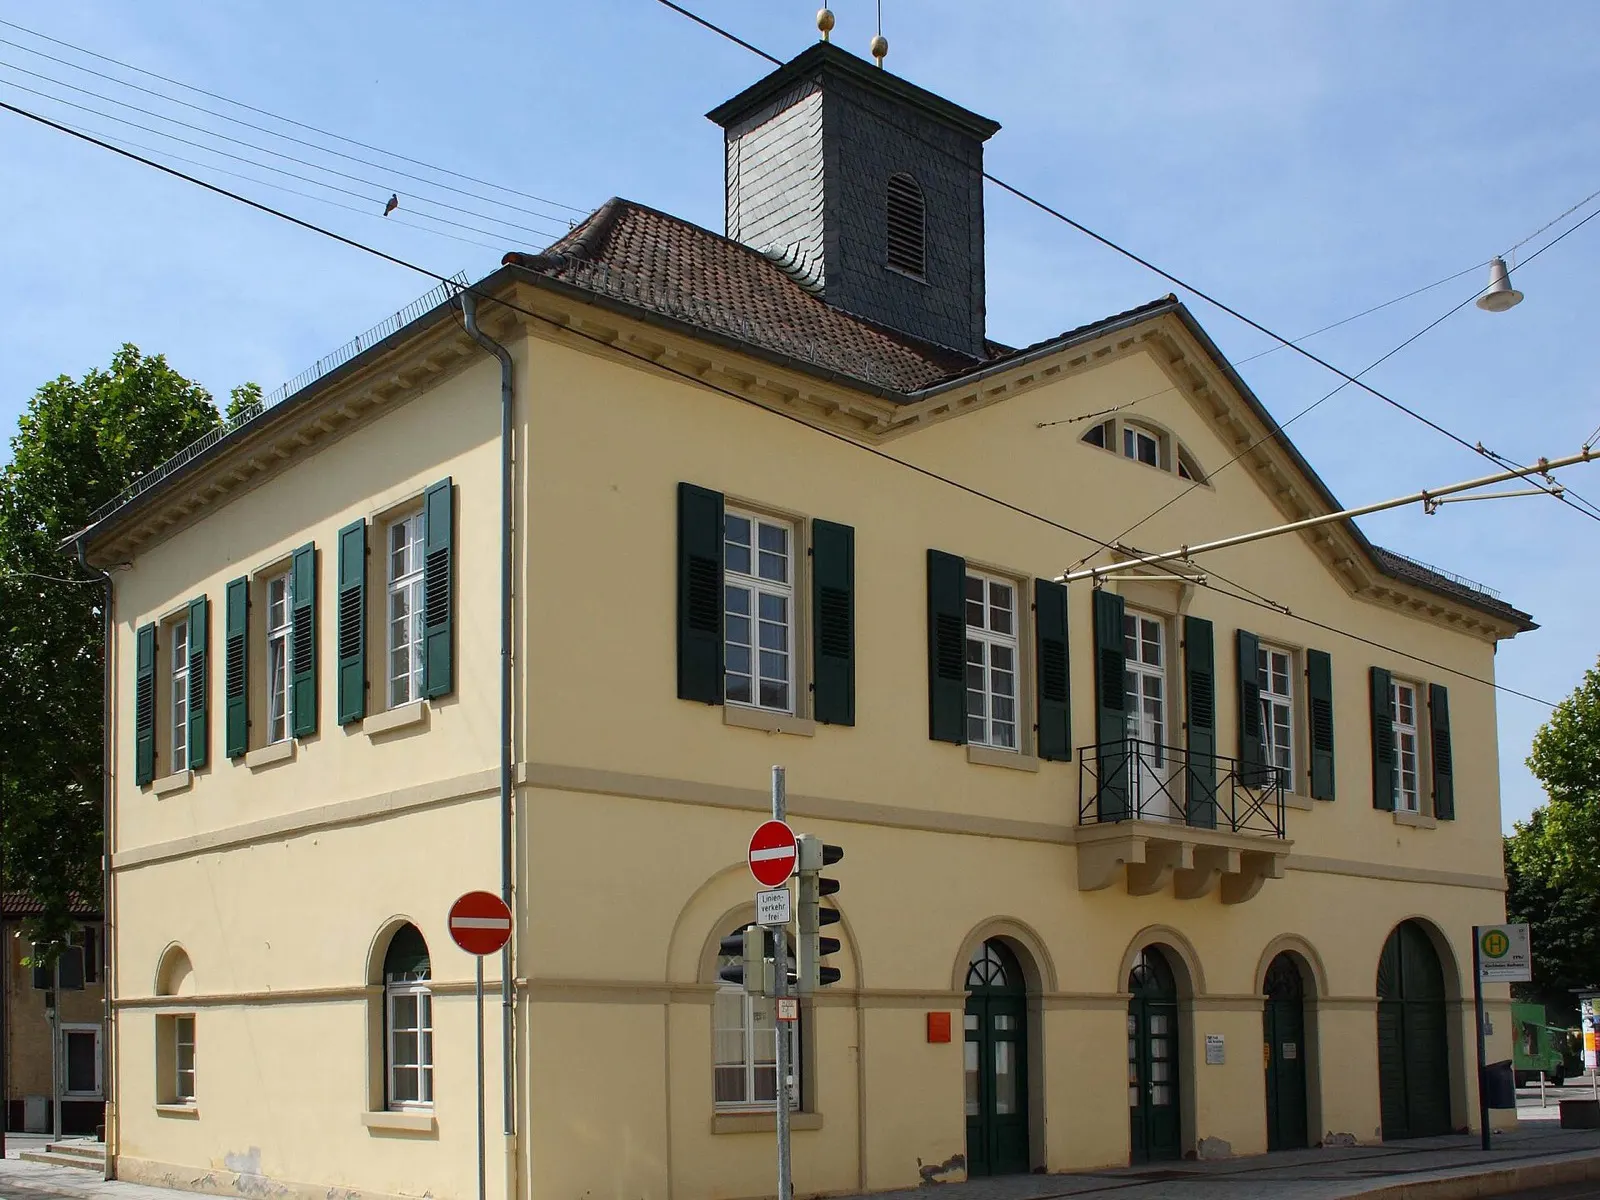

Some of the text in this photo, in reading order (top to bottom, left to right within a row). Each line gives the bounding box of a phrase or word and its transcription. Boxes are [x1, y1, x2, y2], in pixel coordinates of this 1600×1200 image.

[762, 894, 784, 903] Linien-
[761, 903, 785, 912] verkehr
[768, 913, 780, 921] frei
[1490, 935, 1502, 953] H
